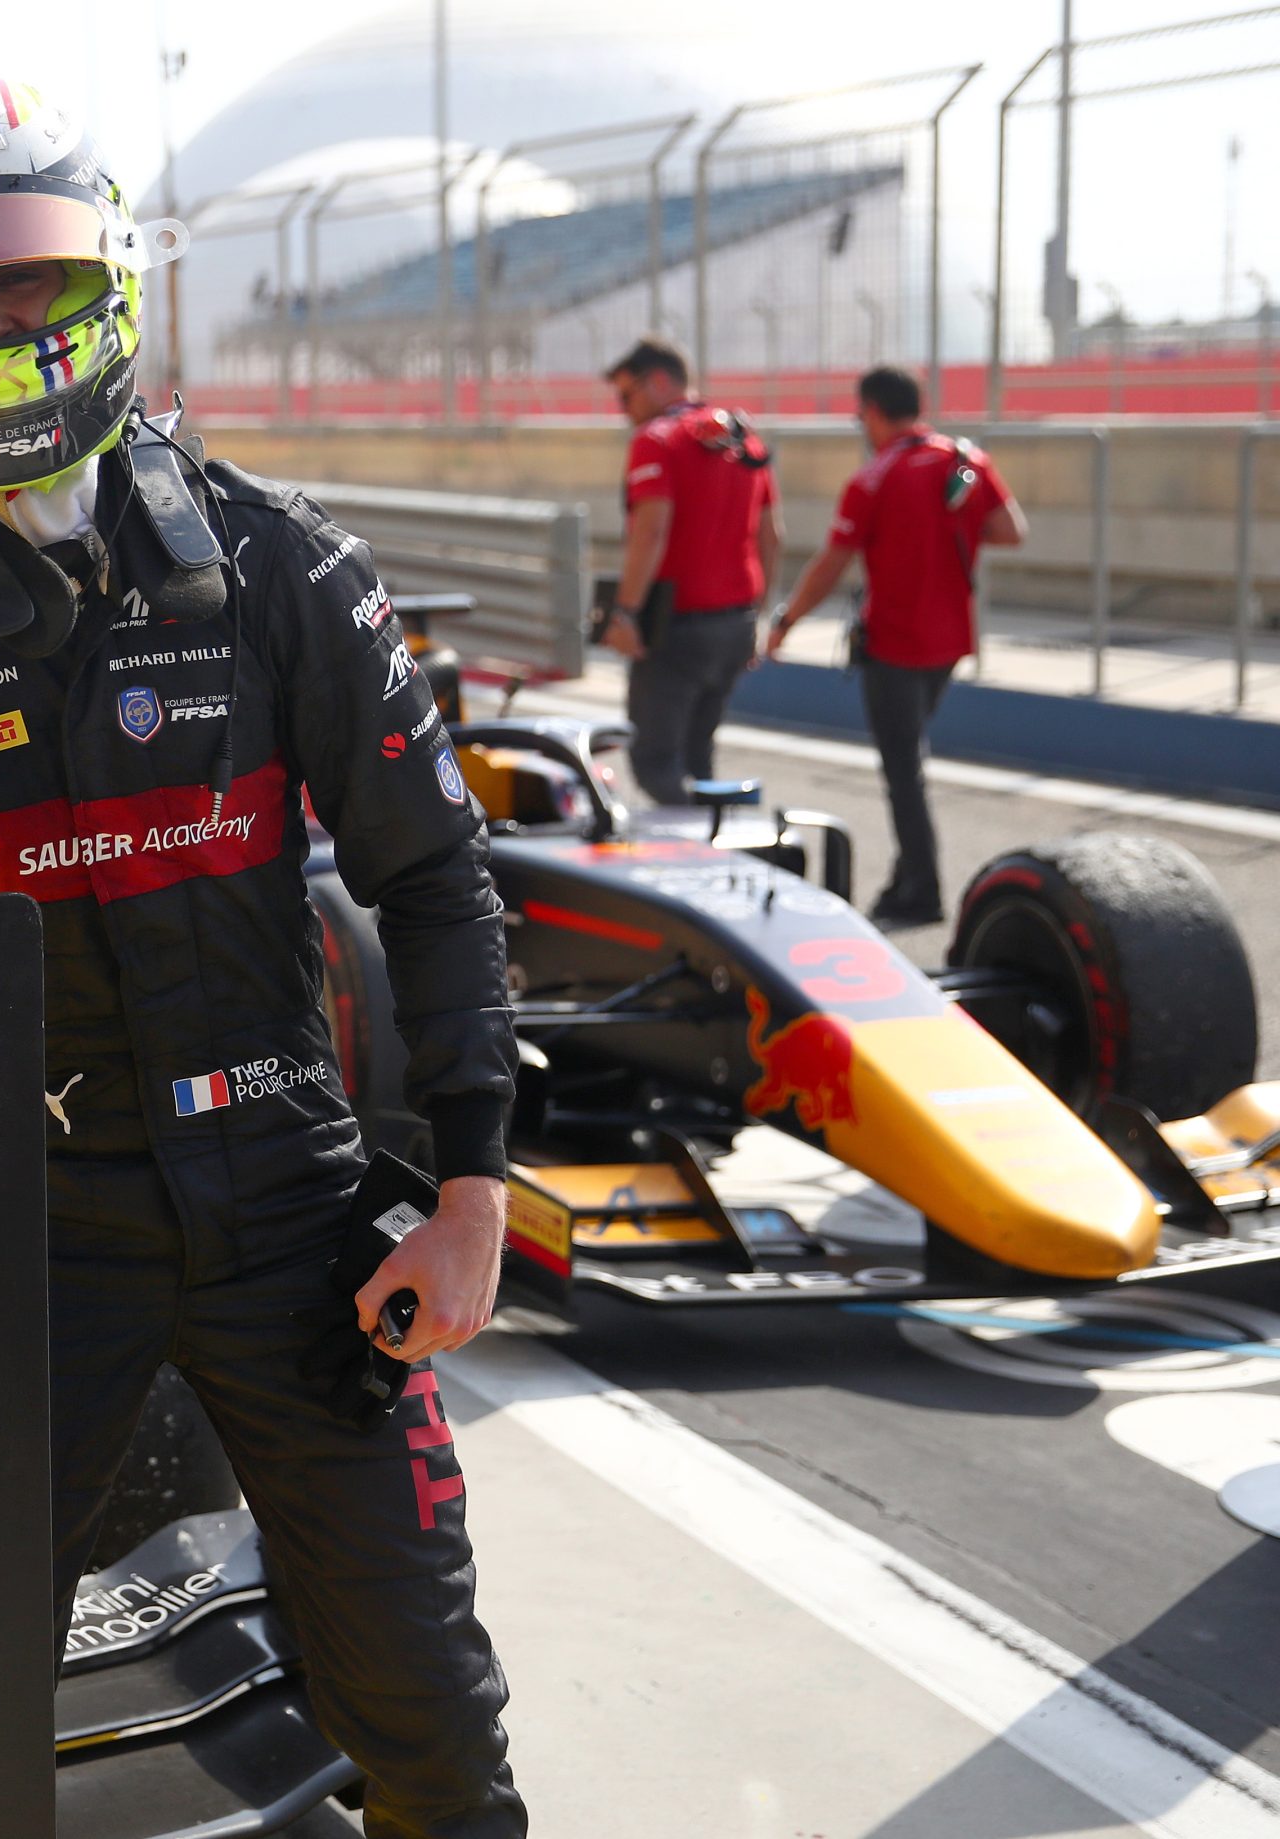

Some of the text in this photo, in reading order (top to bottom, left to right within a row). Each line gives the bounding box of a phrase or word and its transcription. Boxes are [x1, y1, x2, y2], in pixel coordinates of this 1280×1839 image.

[5, 426, 21, 439] DE
[23, 413, 64, 435] FRANCE
[129, 618, 148, 628] PRIX
[109, 646, 232, 672] RICHARD MILLE
[164, 697, 194, 708] EQUIPE
[196, 695, 207, 704] DE
[170, 704, 228, 722] FFSA
[19, 811, 257, 876] SAUBER Academy
[789, 938, 908, 1002] 3
[230, 1057, 279, 1083] THEO
